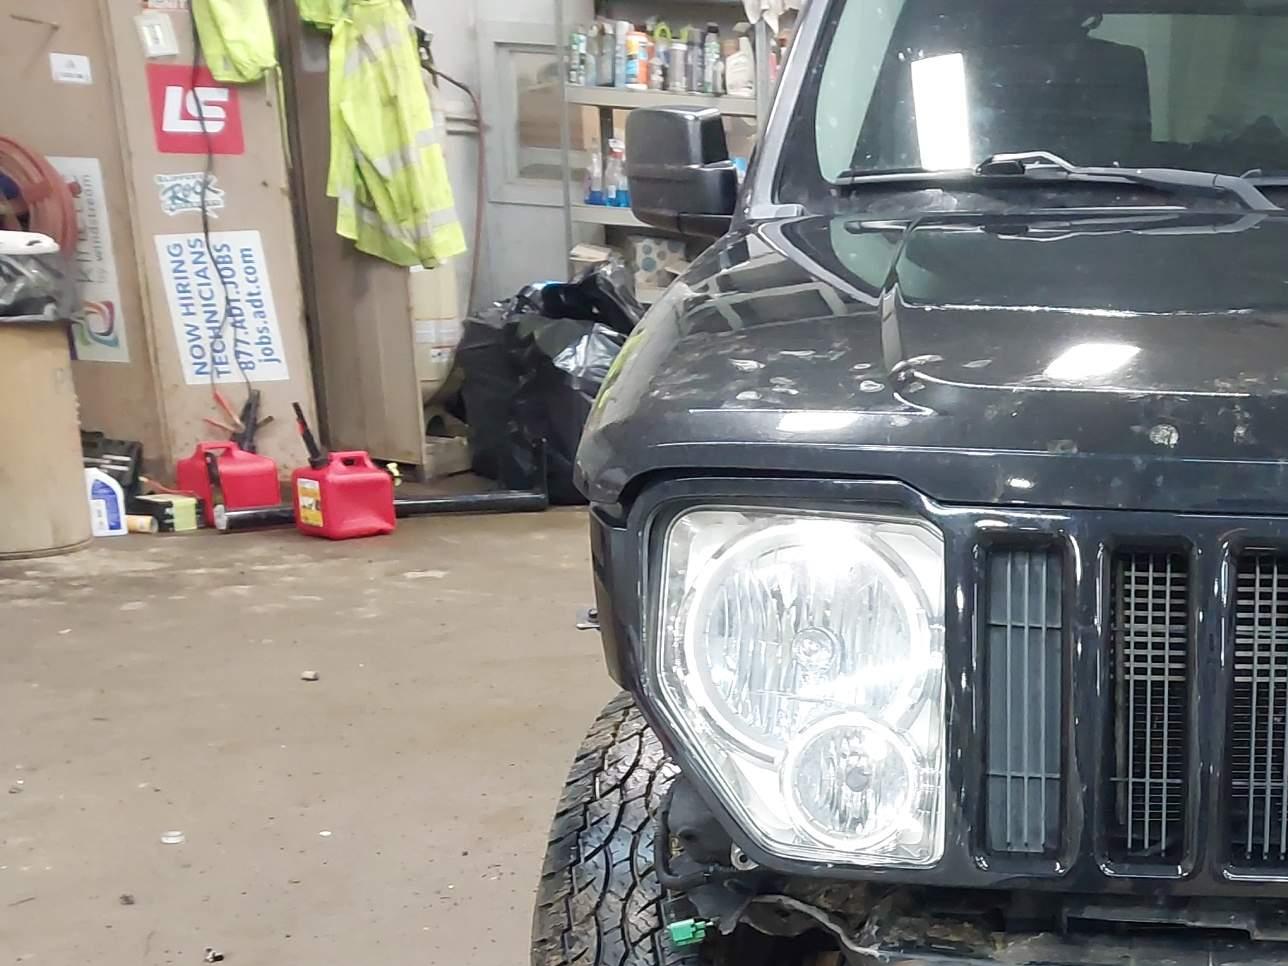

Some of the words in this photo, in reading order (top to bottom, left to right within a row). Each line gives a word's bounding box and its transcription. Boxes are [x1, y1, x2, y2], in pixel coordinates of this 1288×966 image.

[166, 242, 197, 316] HIRING
[187, 237, 232, 379] TECHNICIANS
[213, 243, 256, 371] 877.ADT.JOBS
[239, 247, 281, 364] jobs.adt.com
[184, 323, 210, 376] NOW
